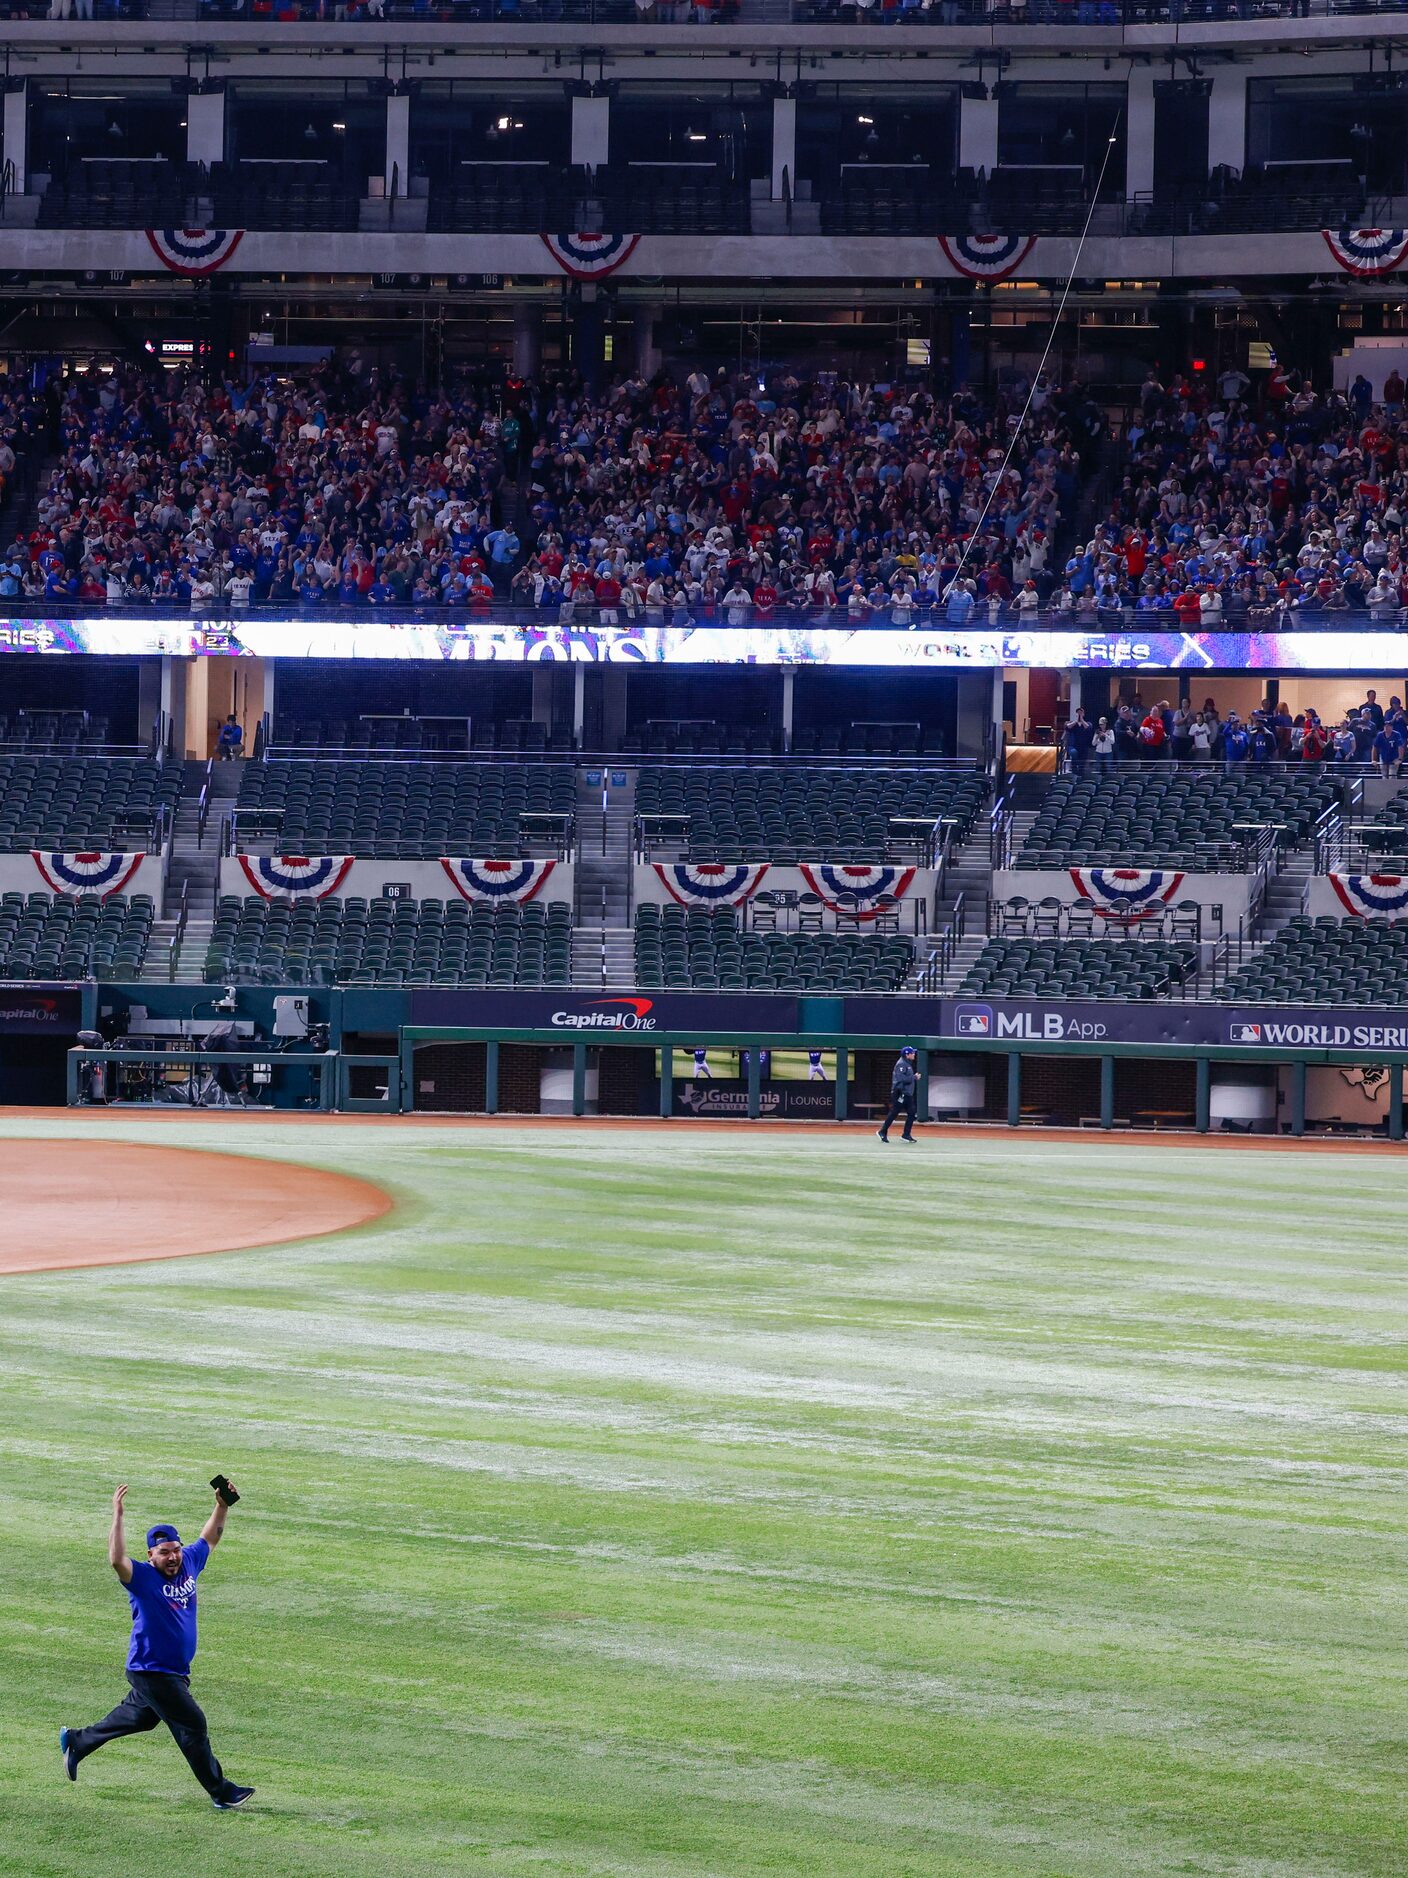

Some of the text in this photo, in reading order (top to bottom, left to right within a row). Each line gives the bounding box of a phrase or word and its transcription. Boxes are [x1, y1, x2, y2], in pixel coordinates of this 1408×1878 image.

[109, 270, 125, 281] 107
[380, 273, 396, 284] 107
[481, 274, 498, 285] 106
[1070, 643, 1151, 660] ERIES
[388, 887, 400, 897] 06
[997, 1012, 1064, 1039] MLB
[1263, 1024, 1351, 1045] WORLD
[708, 1089, 833, 1106] Germnia LOUNGE
